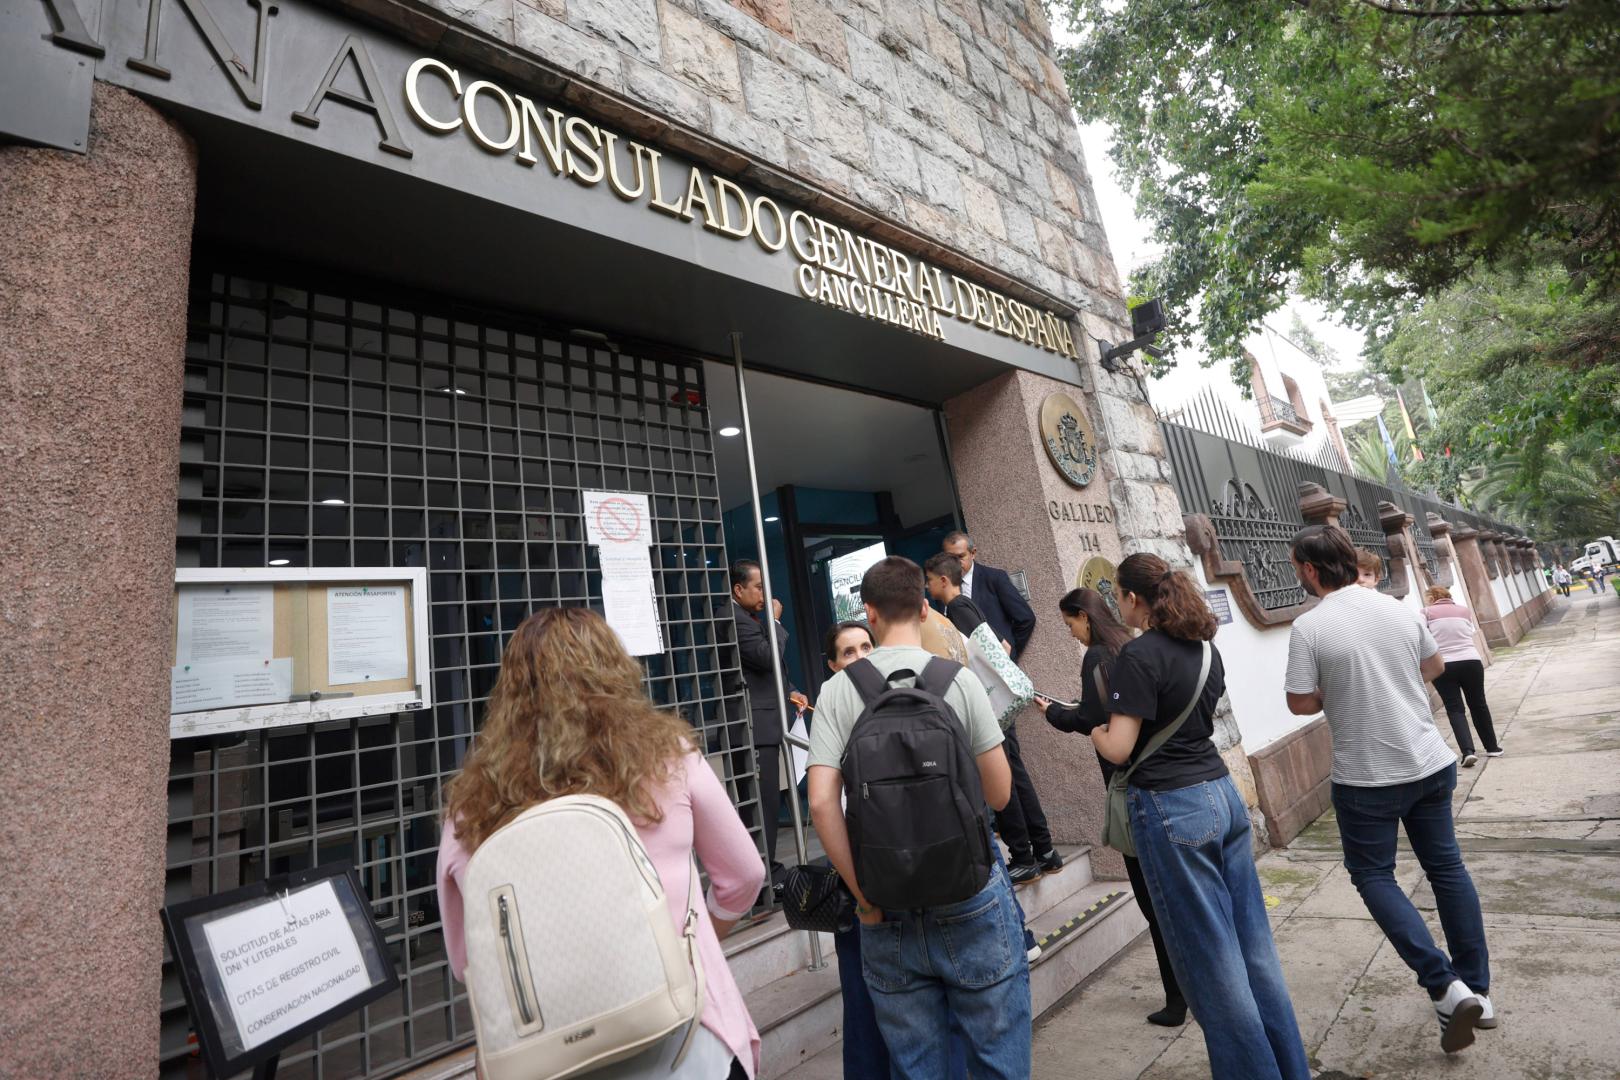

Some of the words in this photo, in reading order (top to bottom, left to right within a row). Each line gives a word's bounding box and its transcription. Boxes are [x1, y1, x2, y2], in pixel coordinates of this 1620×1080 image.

[404, 57, 786, 253] CONSULADO
[787, 209, 956, 317] GENERAL
[951, 274, 994, 331] DE
[988, 290, 1079, 361] ESPAÑA
[798, 262, 946, 341] CANCILLERIA
[1049, 500, 1113, 524] GALILEO
[1079, 533, 1101, 552] 114
[833, 572, 864, 590] CANCILL
[220, 935, 268, 962] SOLICITUD
[269, 929, 282, 941] DE
[283, 916, 310, 935] ACTAS
[309, 908, 331, 923] PARA
[226, 962, 242, 976] DNI
[243, 957, 250, 967] Y
[251, 936, 298, 964] LITERALES
[237, 985, 264, 1006] CITAS
[265, 977, 279, 991] DE
[279, 956, 321, 983] REGISTRO
[321, 946, 341, 962] CIVIL
[311, 964, 361, 998] NACIONALIDAD
